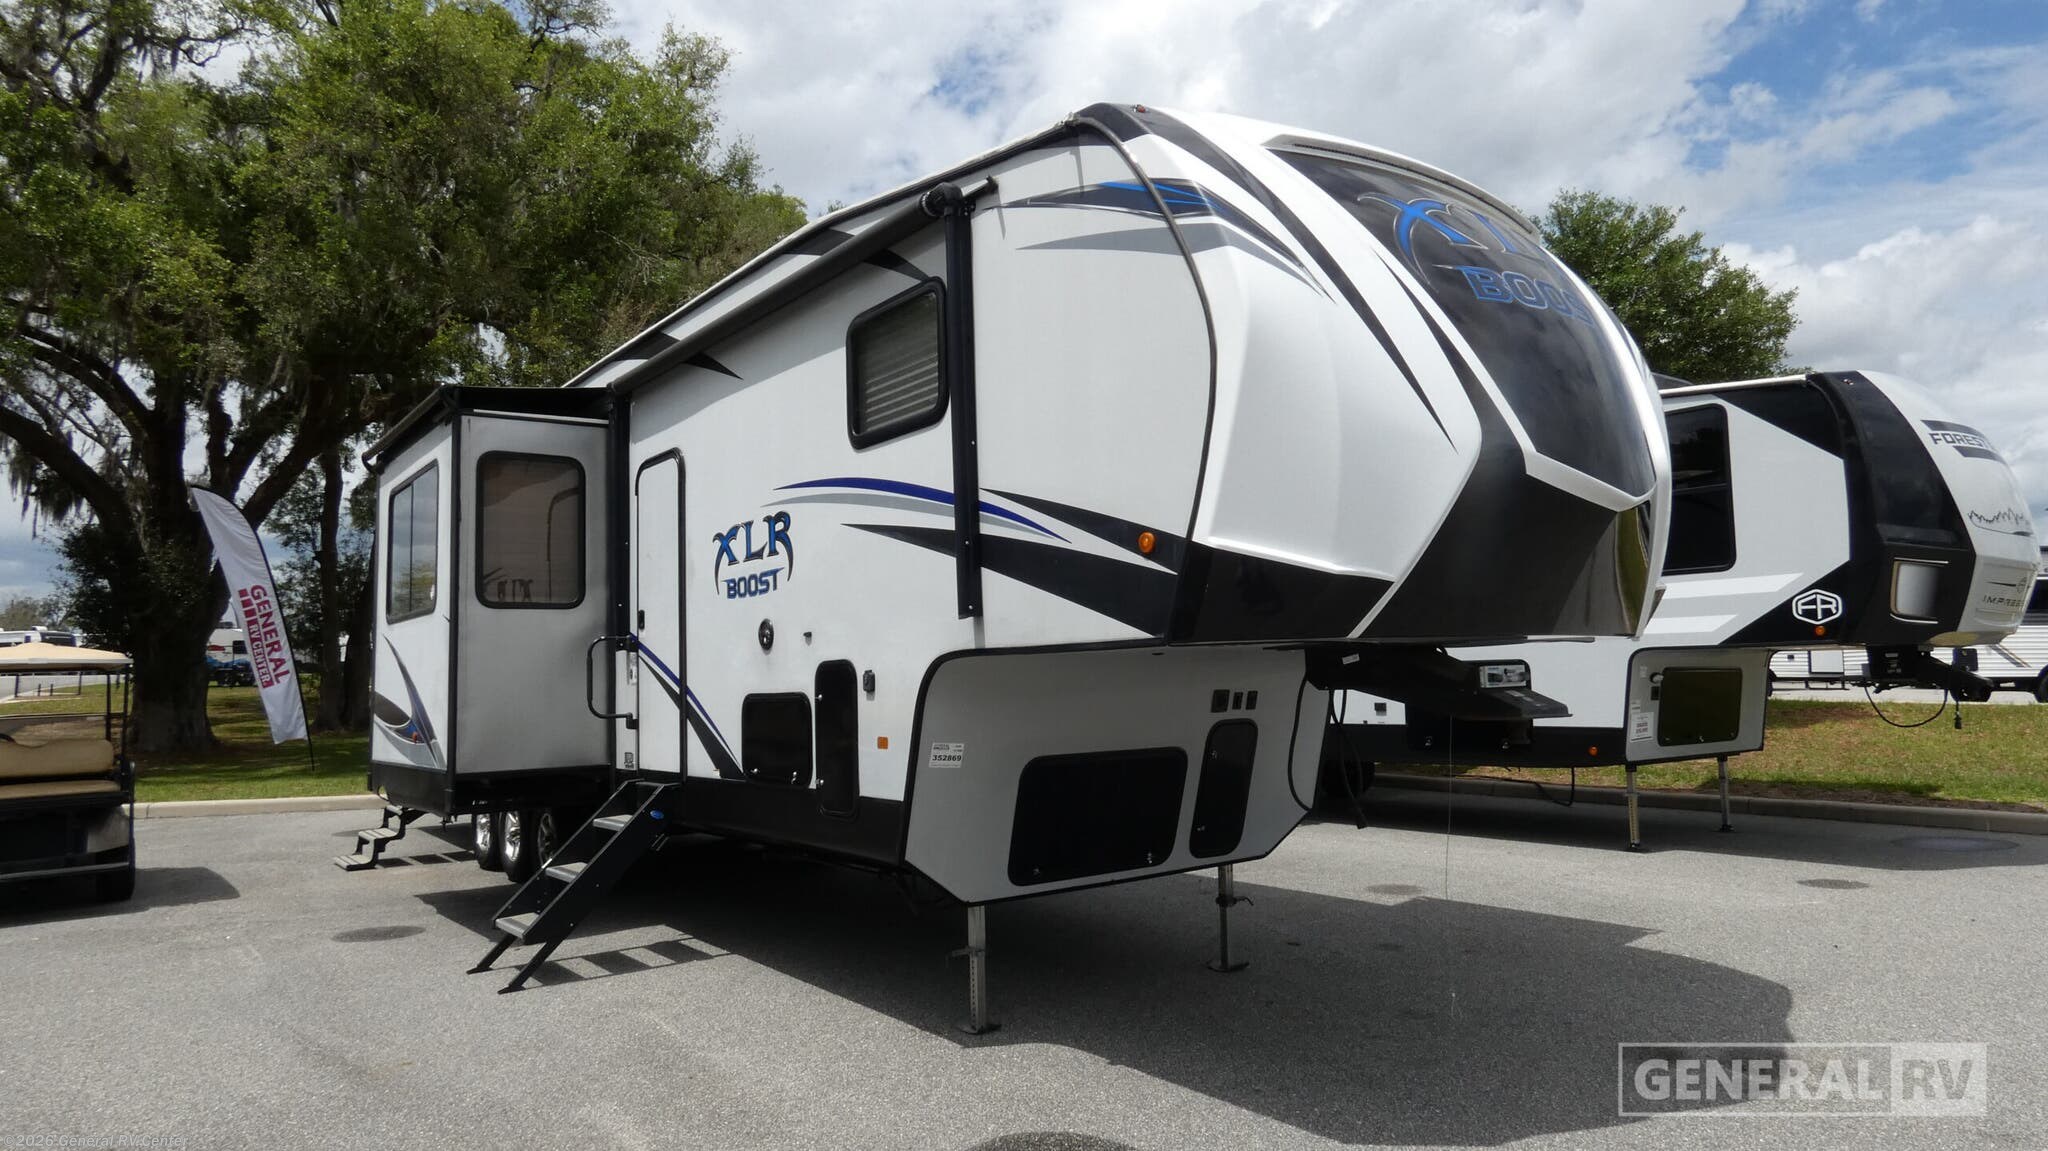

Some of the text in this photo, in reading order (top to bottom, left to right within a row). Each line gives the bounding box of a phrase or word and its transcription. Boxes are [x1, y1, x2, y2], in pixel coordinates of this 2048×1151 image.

[1434, 264, 1594, 327] BOOS
[713, 511, 794, 595] XLR
[721, 567, 785, 599] BOOST
[248, 624, 272, 683] RV CENTER
[251, 585, 290, 684] GENERAL
